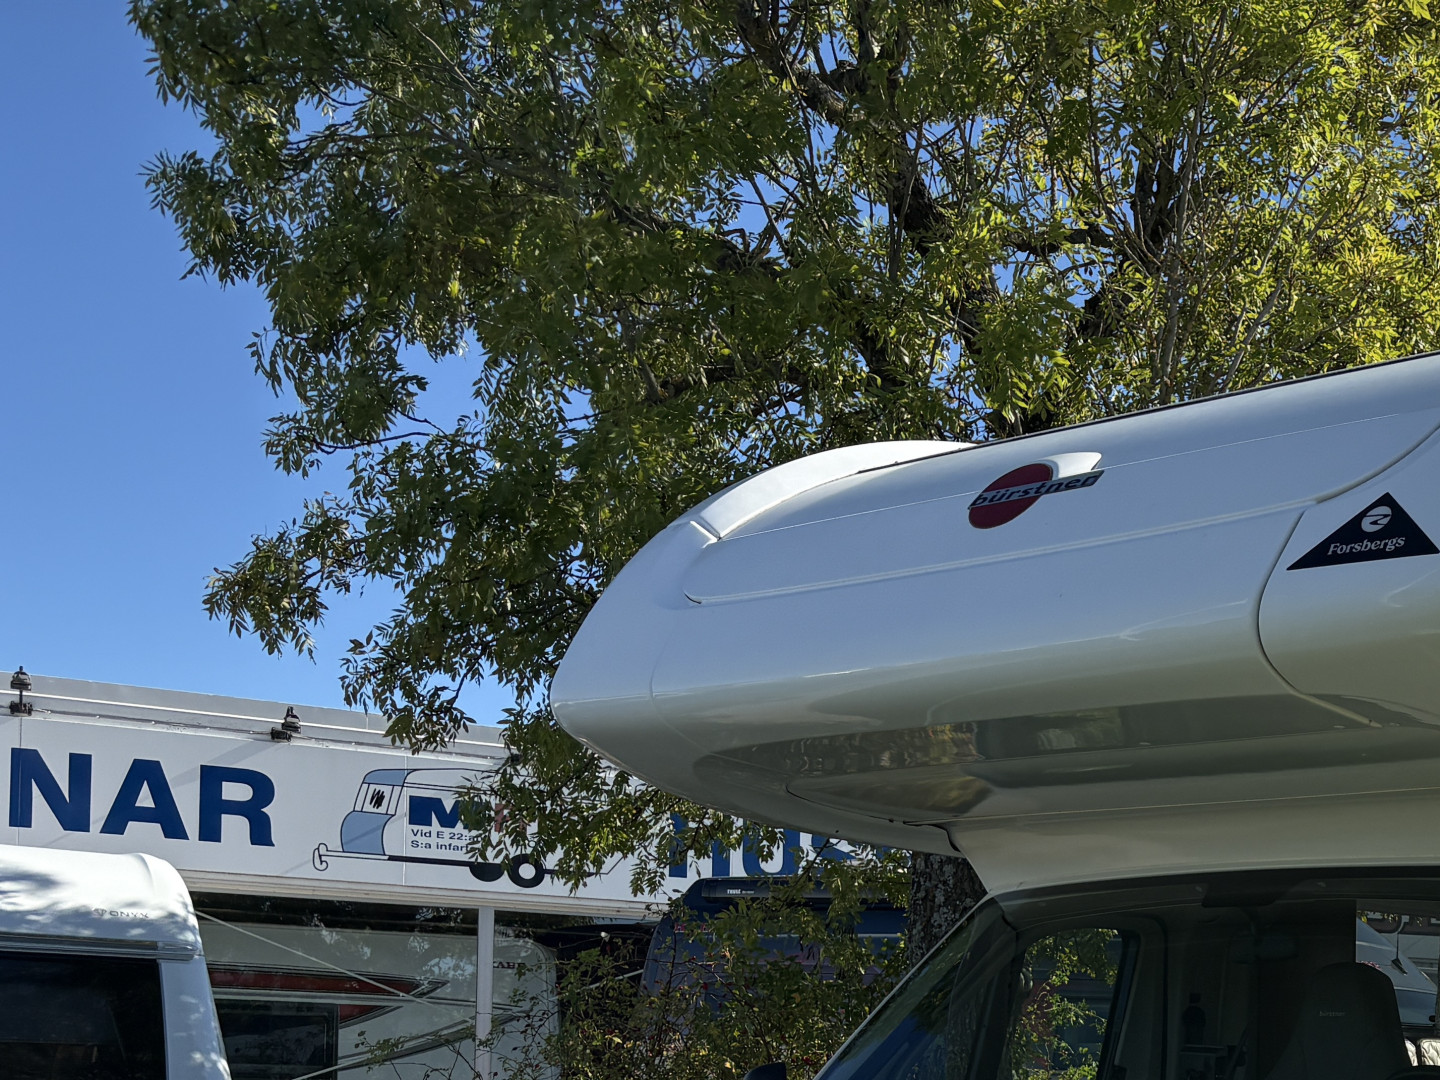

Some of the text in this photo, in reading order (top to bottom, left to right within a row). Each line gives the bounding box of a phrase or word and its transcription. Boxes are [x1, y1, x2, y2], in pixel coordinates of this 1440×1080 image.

[969, 475, 1100, 509] bürstner
[1327, 537, 1406, 556] Forsbergs
[9, 747, 275, 847] NAR
[411, 828, 432, 838] Vid
[436, 831, 445, 839] E
[410, 840, 432, 849] S:a
[109, 910, 149, 919] ONYX
